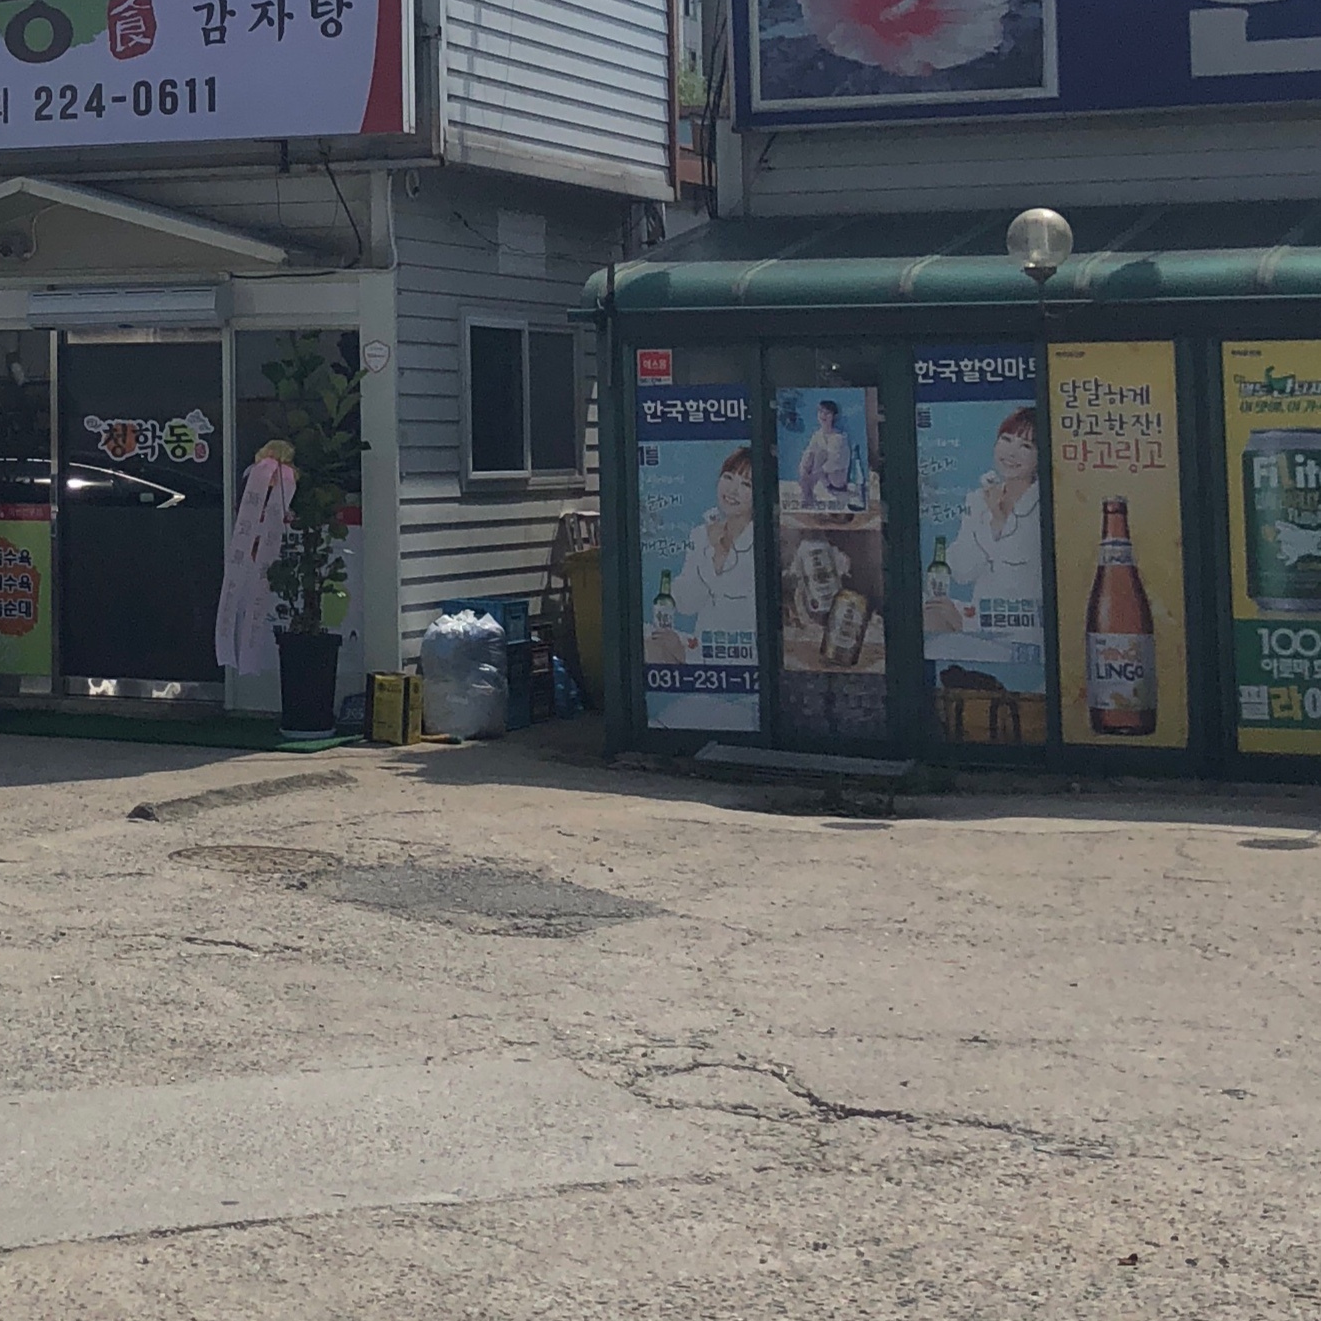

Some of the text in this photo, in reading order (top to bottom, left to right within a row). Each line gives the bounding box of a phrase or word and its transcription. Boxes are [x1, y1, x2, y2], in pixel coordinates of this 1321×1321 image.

[33, 74, 219, 122] 224-0611
[641, 397, 753, 424] 한국할인마
[1059, 377, 1151, 409] 달달하게
[101, 422, 194, 460] 청학동
[1062, 438, 1166, 473] 망고링고
